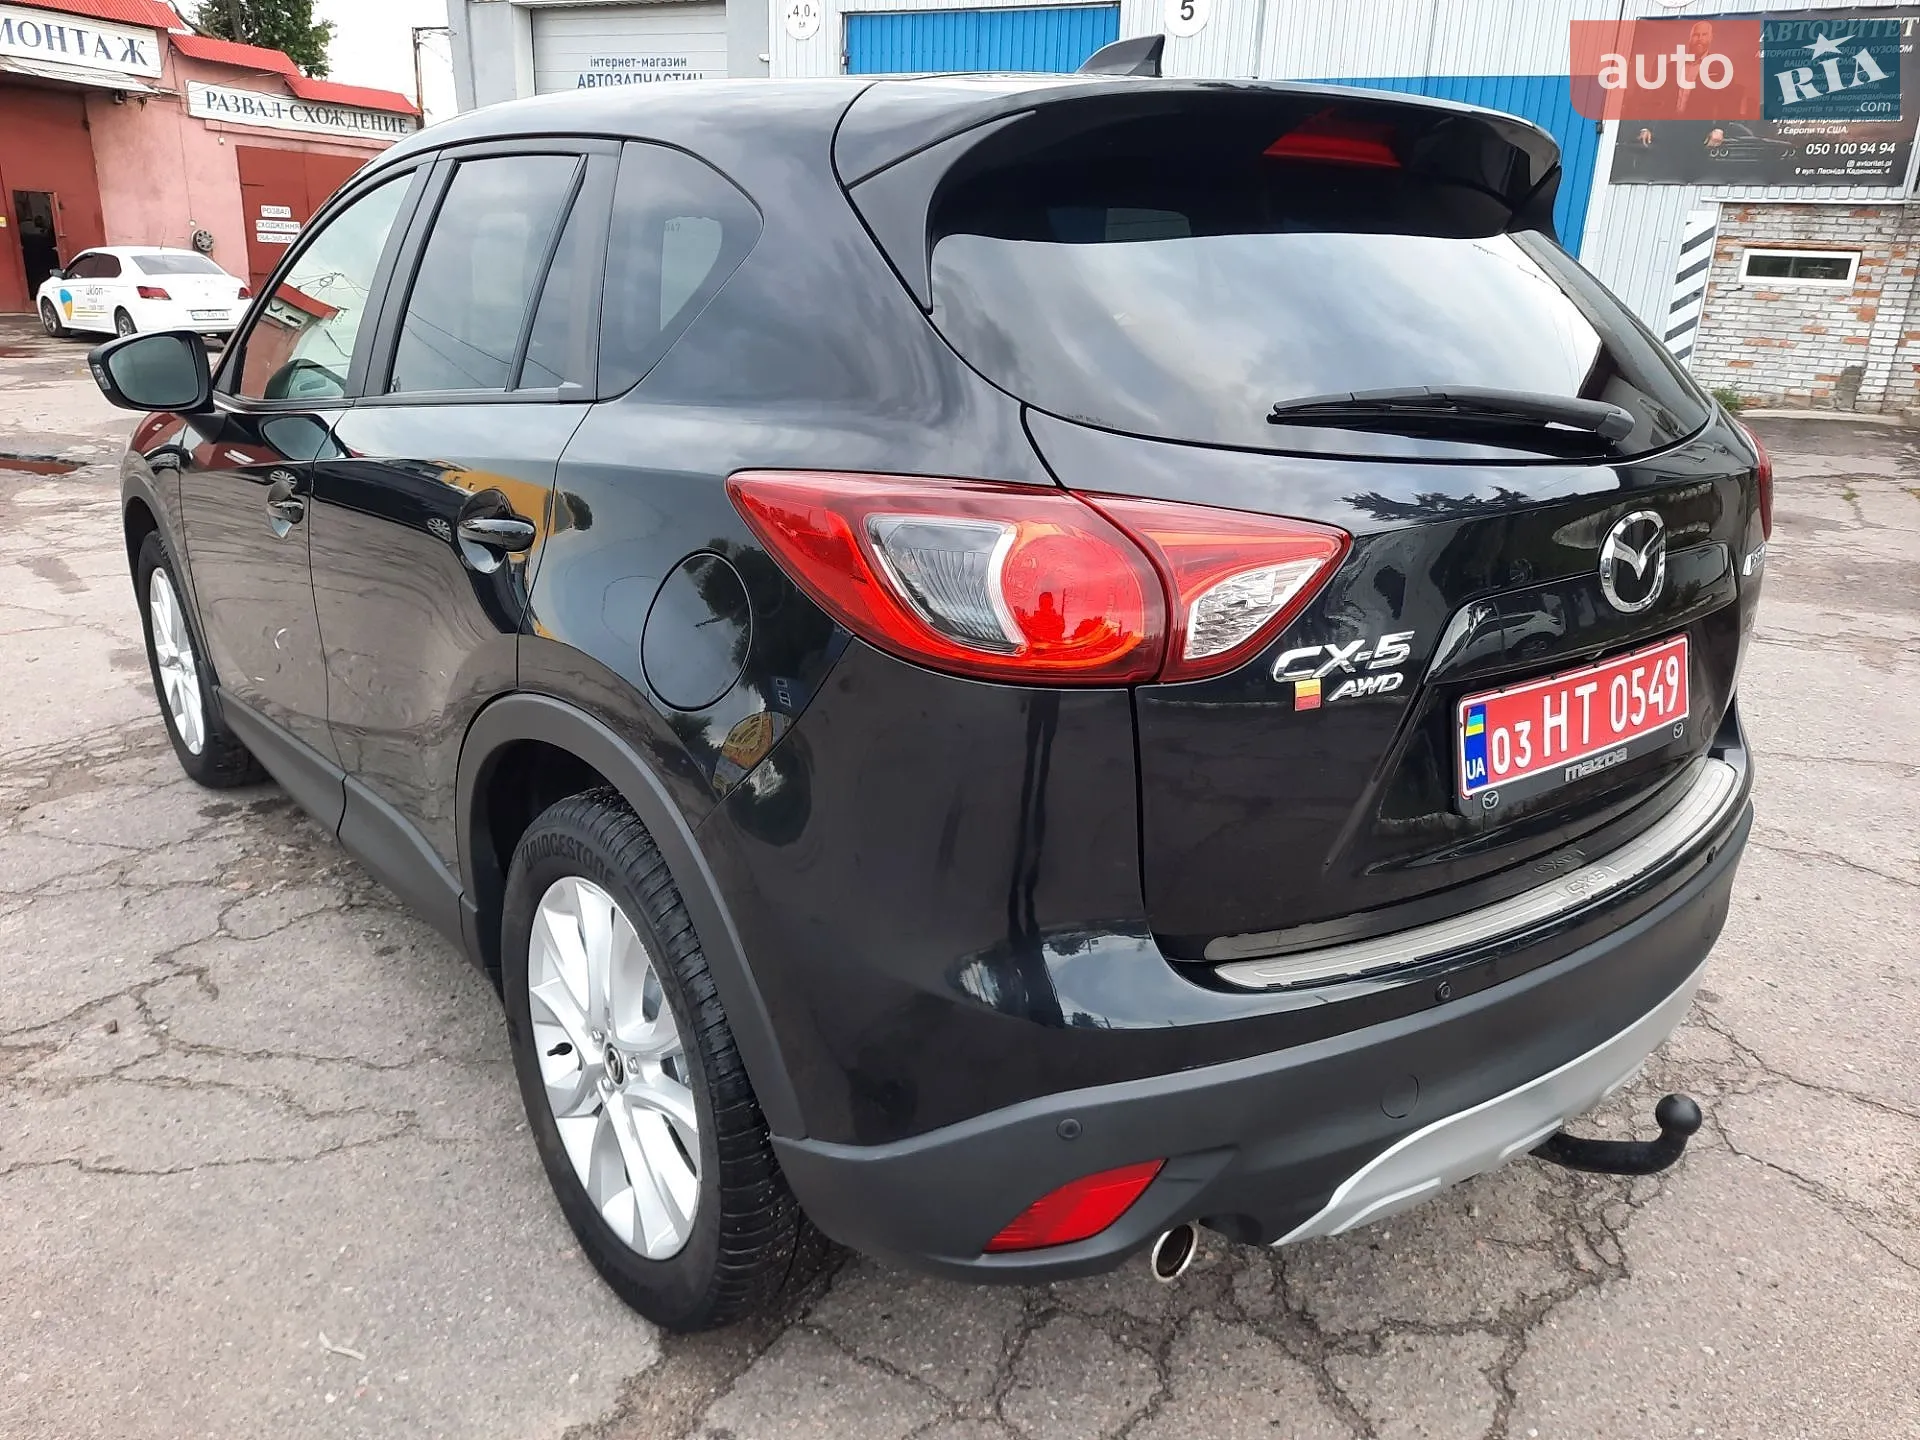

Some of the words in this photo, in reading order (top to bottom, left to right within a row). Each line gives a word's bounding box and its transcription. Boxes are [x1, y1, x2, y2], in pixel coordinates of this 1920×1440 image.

[1180, 0, 1195, 21] 5
[1759, 17, 1919, 42] АВТОРИТЕТ
[590, 56, 687, 69] інтернет-магазин
[205, 91, 409, 134] РАЗВАЛ-СХОЖДЕНИЕ
[1783, 126, 1815, 135] Європи
[1816, 126, 1826, 134] та
[1805, 143, 1830, 155] 050
[1834, 143, 1858, 155] 100
[1859, 143, 1876, 154] 94
[1879, 142, 1896, 154] 94
[1270, 630, 1416, 683] CX-5
[1326, 671, 1404, 702] AWD
[1491, 719, 1532, 775] 03
[1542, 681, 1599, 758] HT
[1609, 655, 1680, 734] 0549
[1465, 757, 1486, 781] UA
[1563, 747, 1628, 783] mazda
